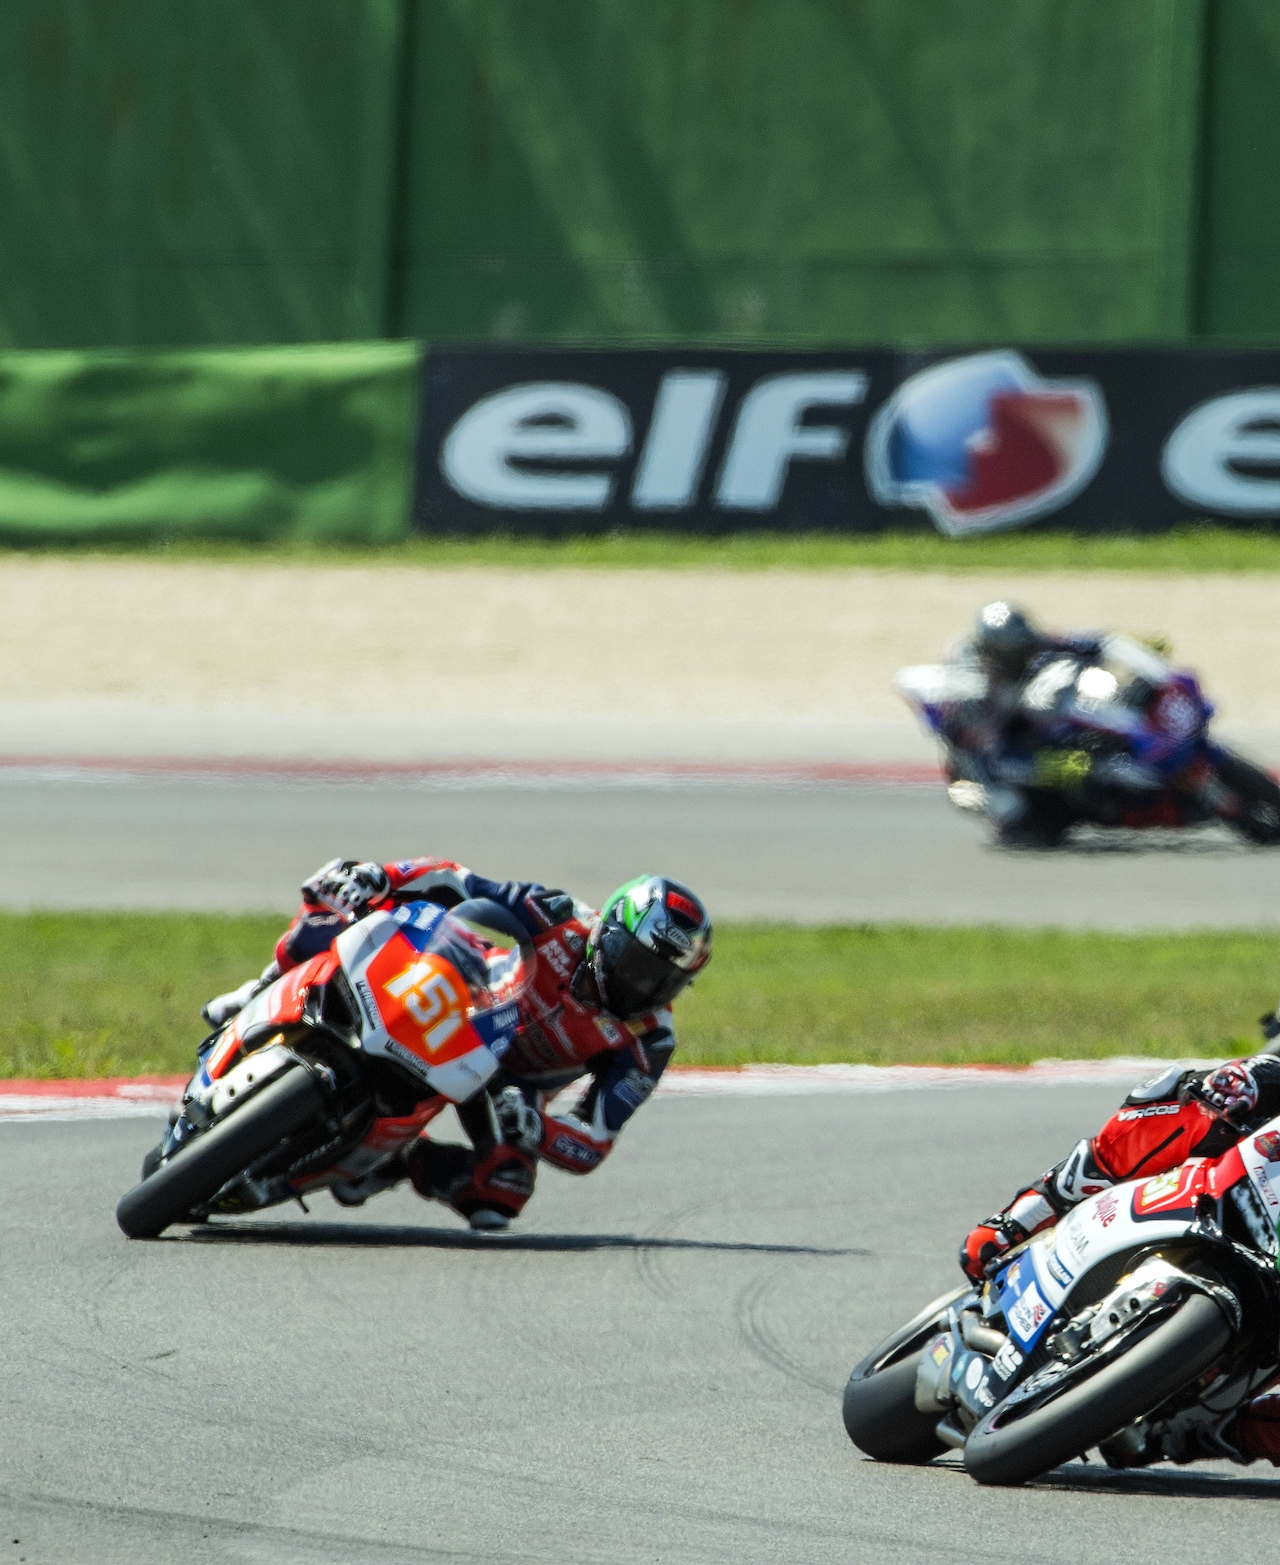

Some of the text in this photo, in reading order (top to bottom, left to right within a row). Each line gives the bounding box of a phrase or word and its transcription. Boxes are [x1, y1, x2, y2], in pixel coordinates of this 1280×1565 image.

[382, 960, 464, 1054] 151
[1117, 1104, 1180, 1122] VIRCOS
[1253, 1166, 1279, 1206] MOTUL
